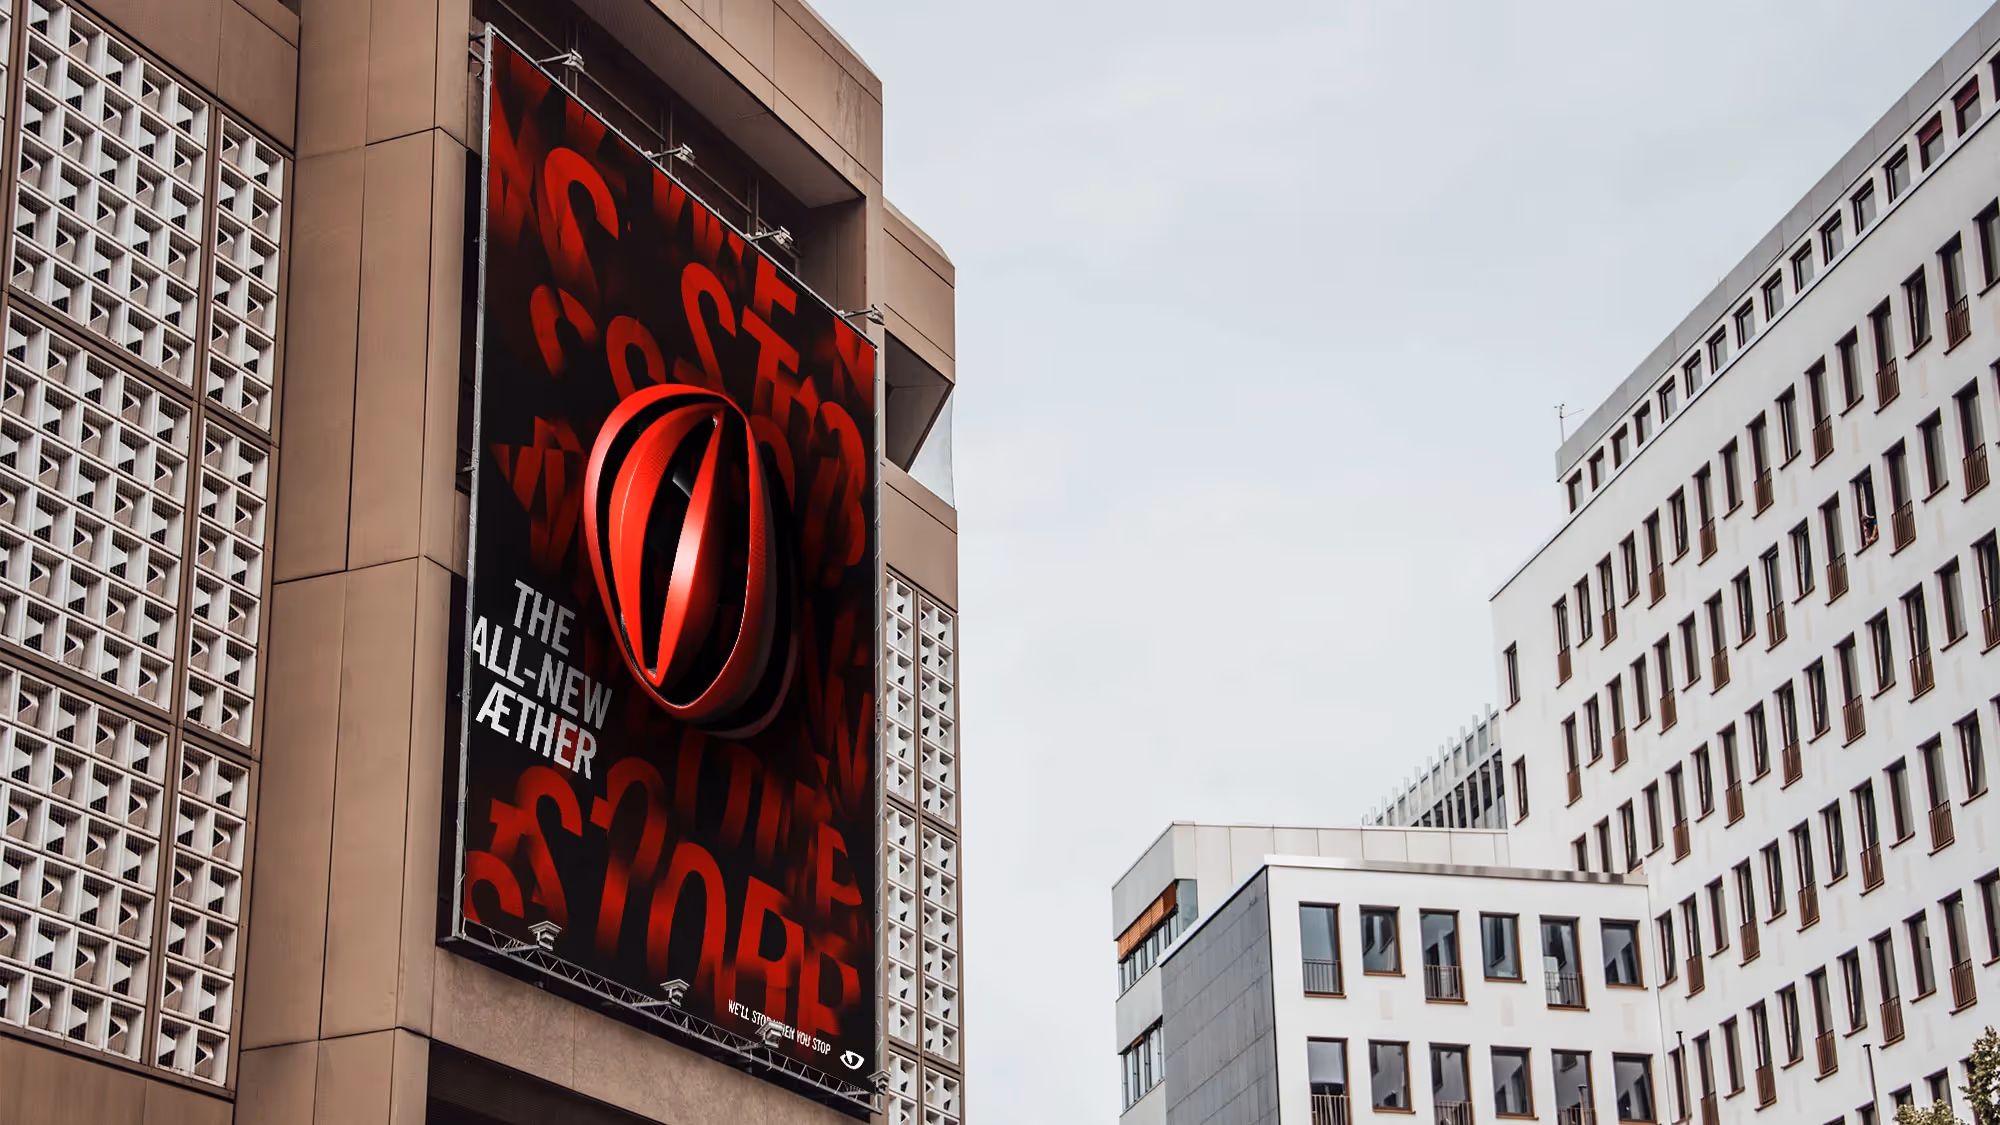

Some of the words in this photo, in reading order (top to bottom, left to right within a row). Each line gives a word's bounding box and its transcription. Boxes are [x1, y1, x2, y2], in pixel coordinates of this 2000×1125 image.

[514, 579, 576, 657] THE
[473, 615, 613, 730] ALL-NEW
[475, 681, 597, 780] ÆTHER
[728, 999, 750, 1021] WE'LL
[797, 1030, 811, 1046] YOU
[812, 1038, 831, 1055] STOP
